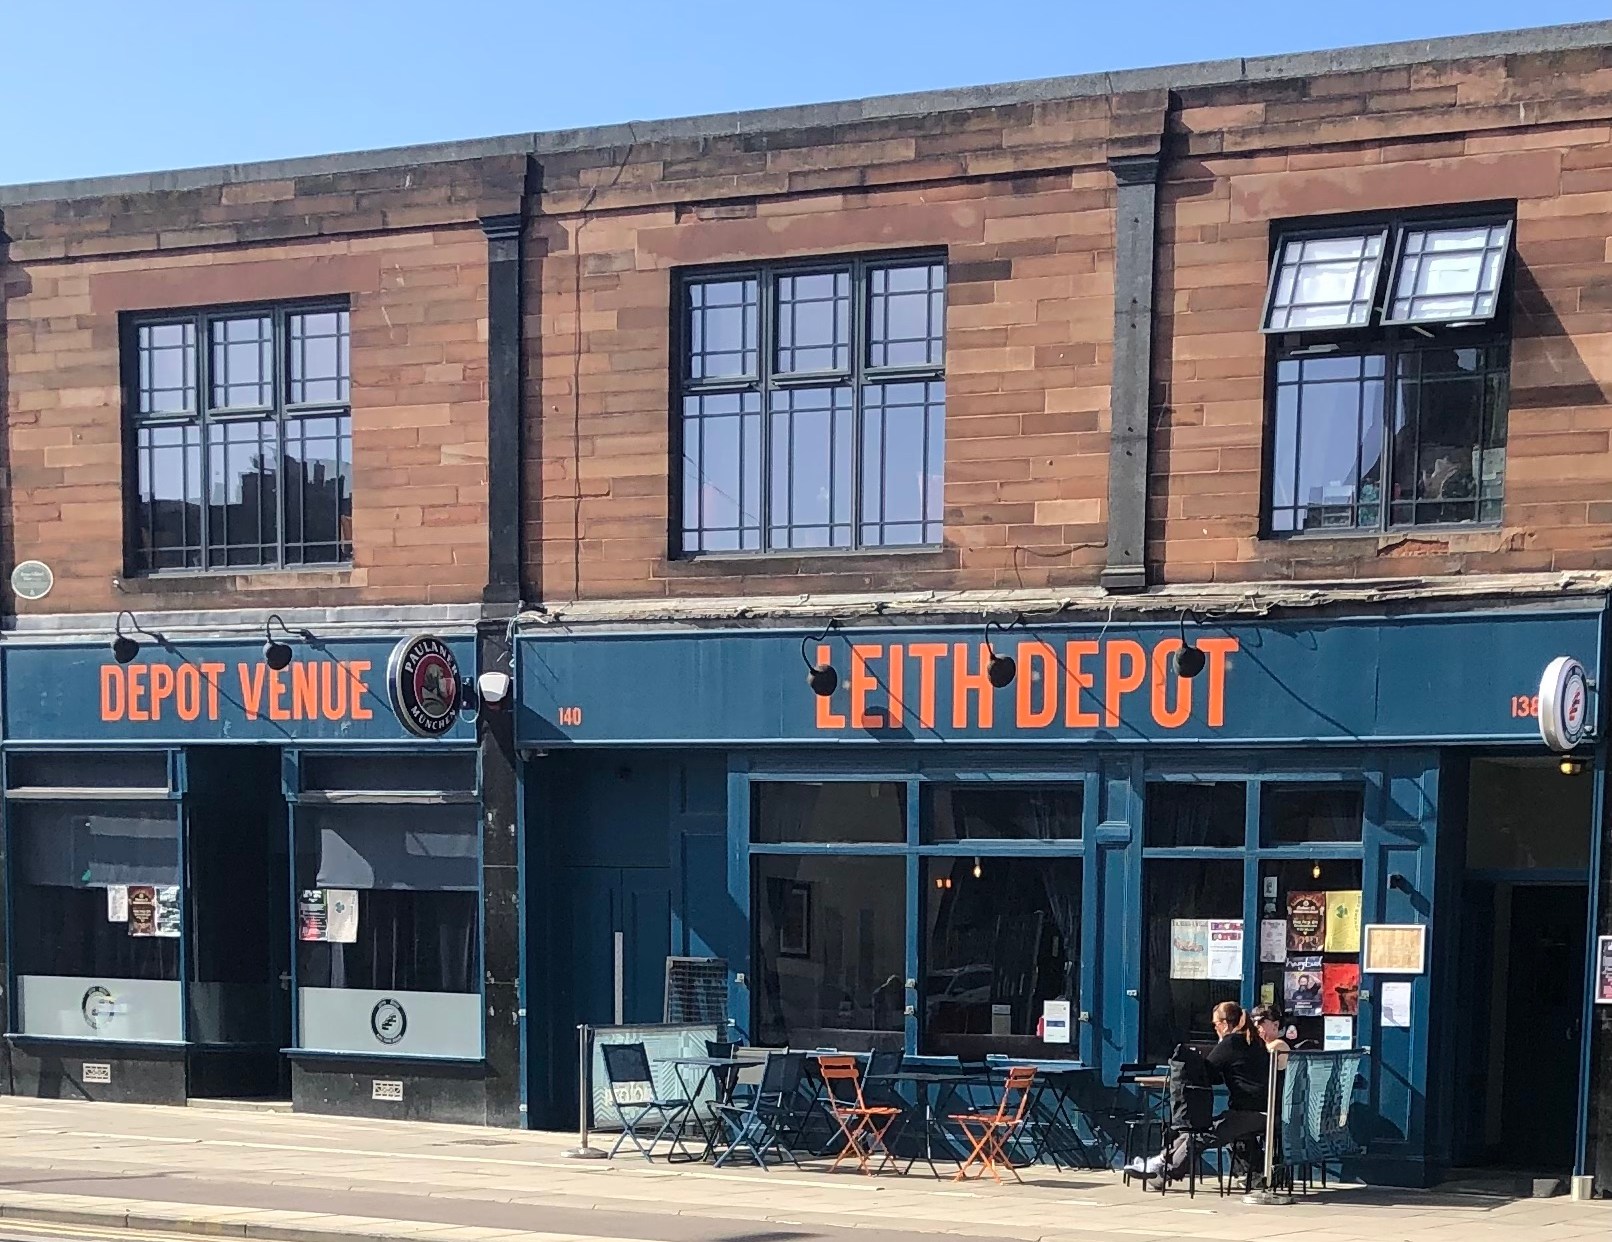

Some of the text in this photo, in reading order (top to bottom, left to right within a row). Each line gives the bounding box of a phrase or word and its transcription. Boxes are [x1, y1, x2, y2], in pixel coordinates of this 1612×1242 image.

[404, 641, 458, 676] PAULANER
[100, 660, 373, 721] DEPOT VENUE
[816, 637, 1240, 729] LEITH DEPOT
[558, 706, 582, 726] 140
[1511, 696, 1539, 718] 138
